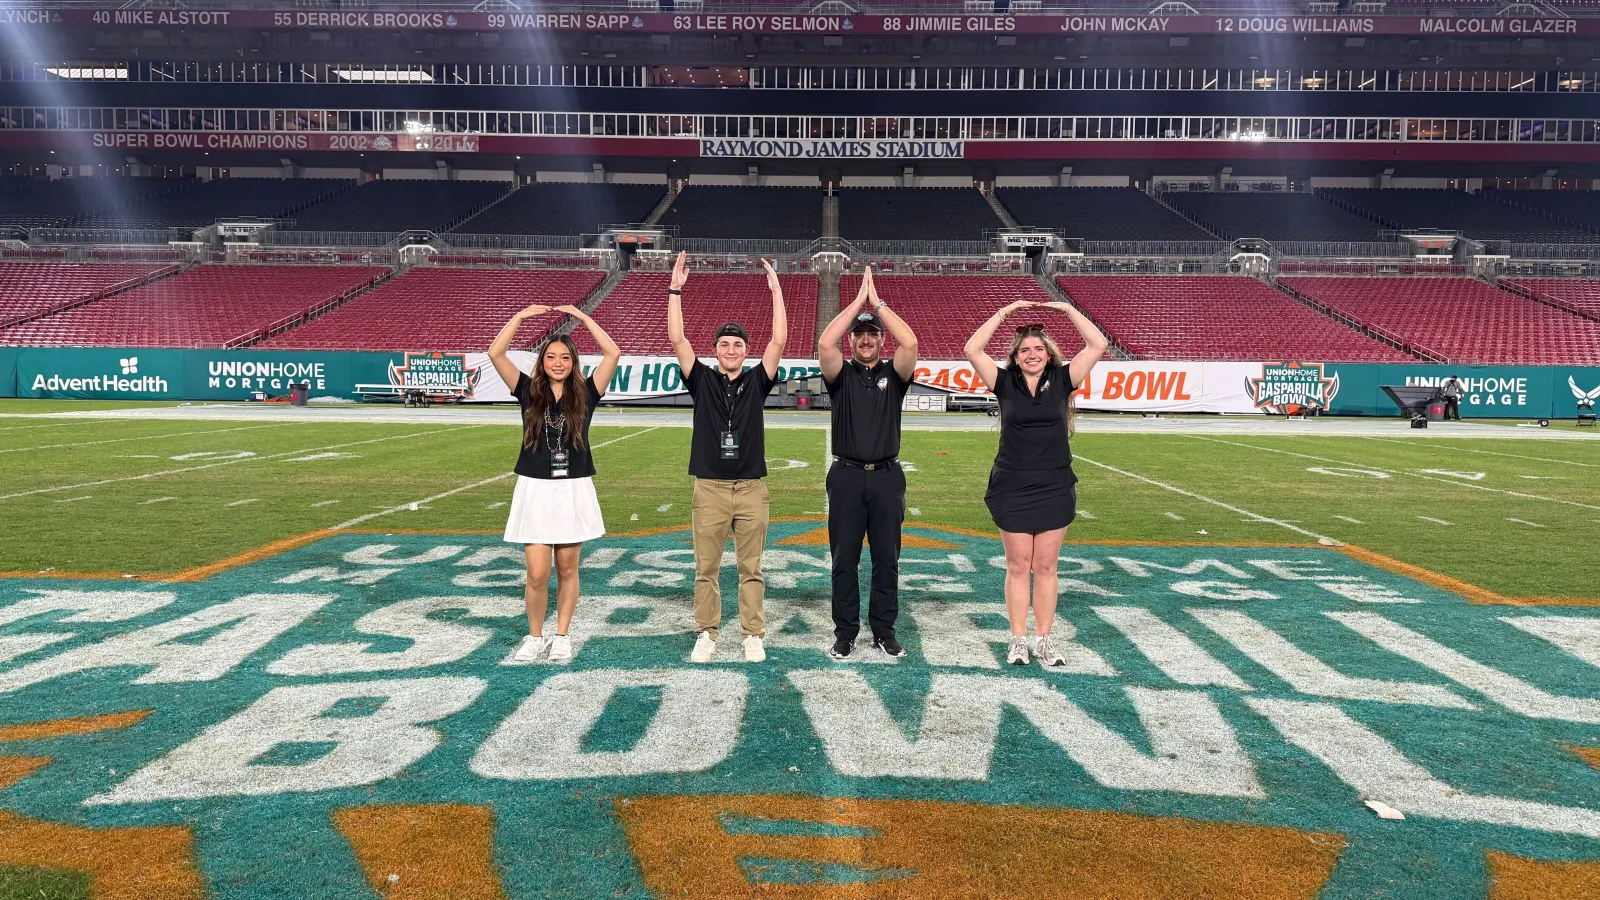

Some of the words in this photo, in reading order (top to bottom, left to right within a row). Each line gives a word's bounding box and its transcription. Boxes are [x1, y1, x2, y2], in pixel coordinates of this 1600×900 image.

[0, 10, 49, 23] LYNCH
[93, 11, 110, 23] 40
[115, 11, 153, 24] MIKE
[158, 12, 230, 25] ALSTOTT
[274, 13, 291, 25] 55
[296, 13, 368, 26] DERRICK
[373, 14, 443, 27] BROOKS
[487, 14, 506, 27] 99
[510, 15, 581, 28] WARREN
[585, 15, 630, 28] SAPP
[673, 16, 692, 29] 63
[696, 16, 728, 30] LEE
[732, 17, 767, 30] ROY
[771, 17, 840, 31] SELMON
[883, 17, 901, 31] 88
[905, 17, 962, 31] JIMMIE
[966, 17, 1016, 31] GILES
[1060, 17, 1106, 31] JOHN
[1111, 17, 1170, 31] MCKAY
[1215, 18, 1234, 32] 12
[1238, 18, 1287, 32] DOUG
[1292, 18, 1374, 32] WILLIAMS
[1419, 18, 1504, 33] MALCOLM
[1509, 19, 1577, 33] GLAZER
[93, 133, 148, 147] SUPER
[153, 134, 204, 148] BOWL
[207, 134, 308, 149] CHAMPIONS
[329, 135, 368, 149] 2002
[415, 135, 453, 150] 2020
[701, 140, 804, 158] RAYMOND
[806, 141, 872, 158] JAMES
[876, 141, 963, 158] STADIUM
[208, 361, 325, 378] UNIONHOME
[410, 358, 462, 367] UNIONHOME
[1266, 368, 1318, 377] UNIONHOME
[32, 374, 168, 392] AdventHealth
[1101, 370, 1191, 400] BOWL
[1257, 381, 1325, 404] GASPARILLA
[1272, 393, 1308, 406] BOWL
[82, 662, 1600, 838] BOWL
